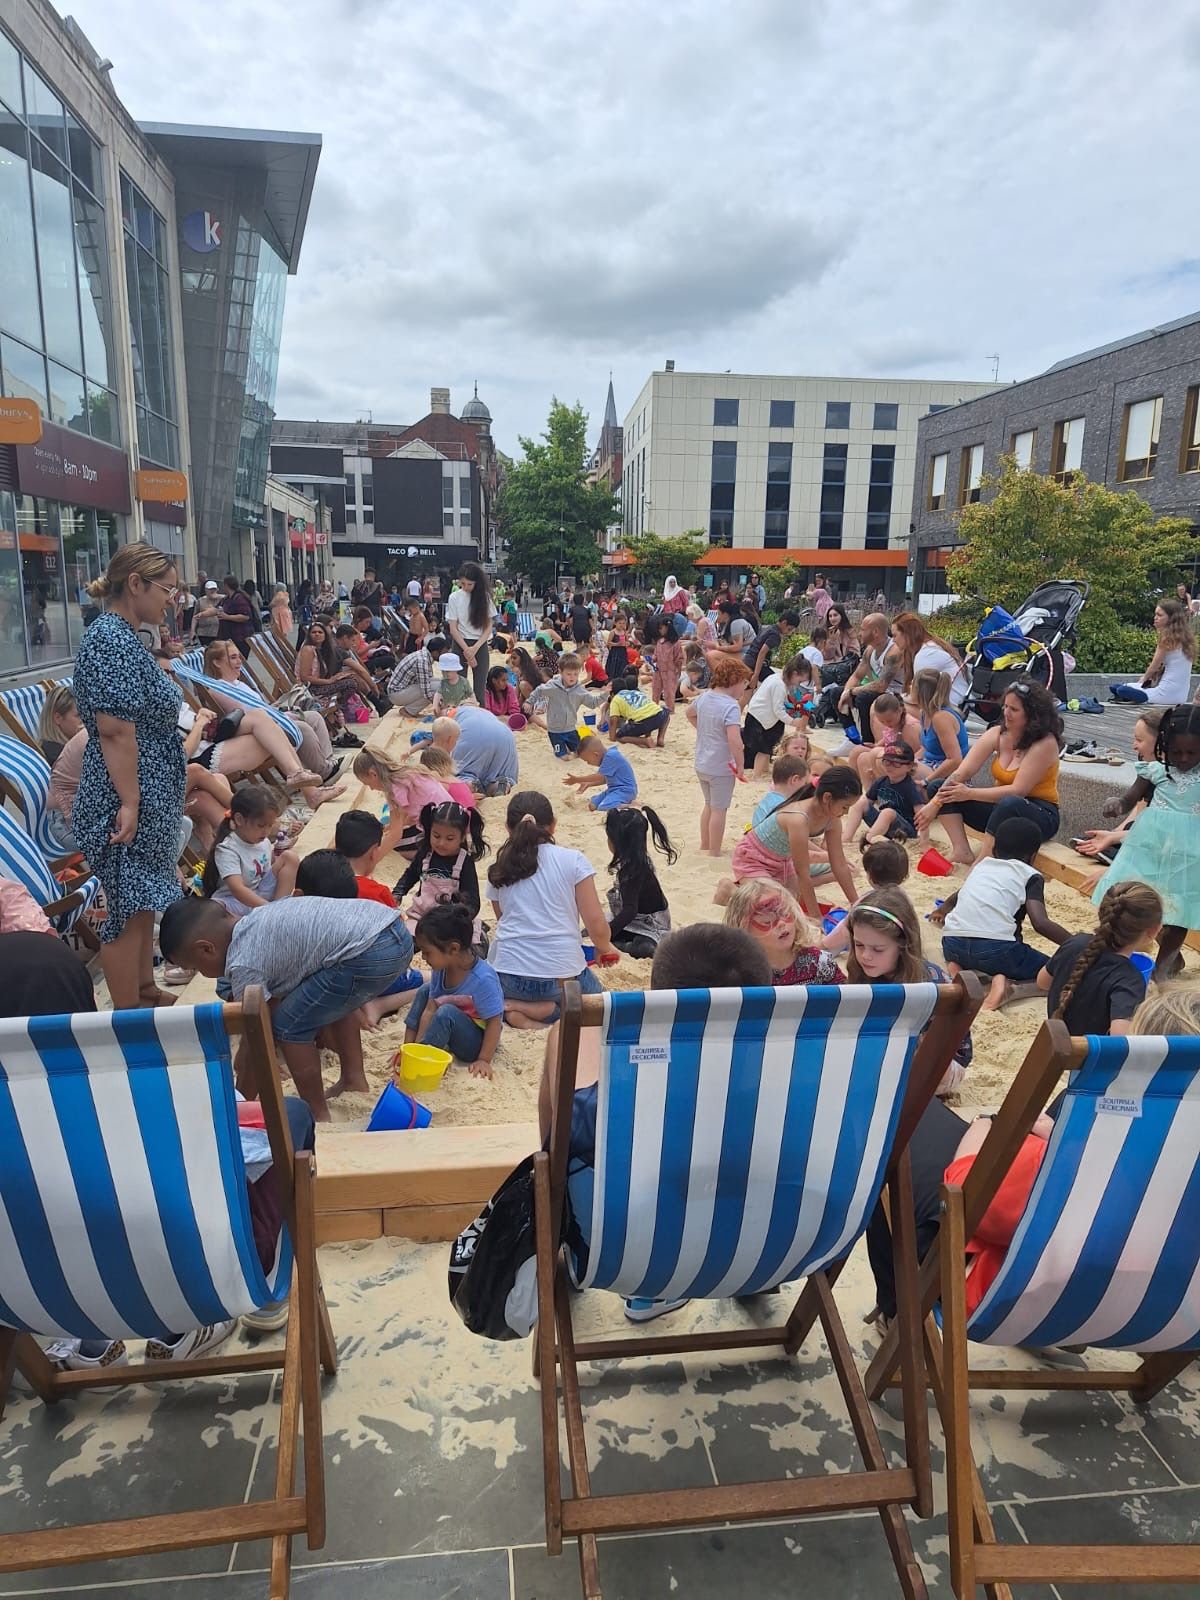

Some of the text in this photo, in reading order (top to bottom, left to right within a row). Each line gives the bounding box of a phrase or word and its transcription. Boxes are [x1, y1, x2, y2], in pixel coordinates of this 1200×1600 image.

[204, 210, 221, 246] k
[63, 458, 78, 477] 8am
[82, 464, 98, 484] 10pm
